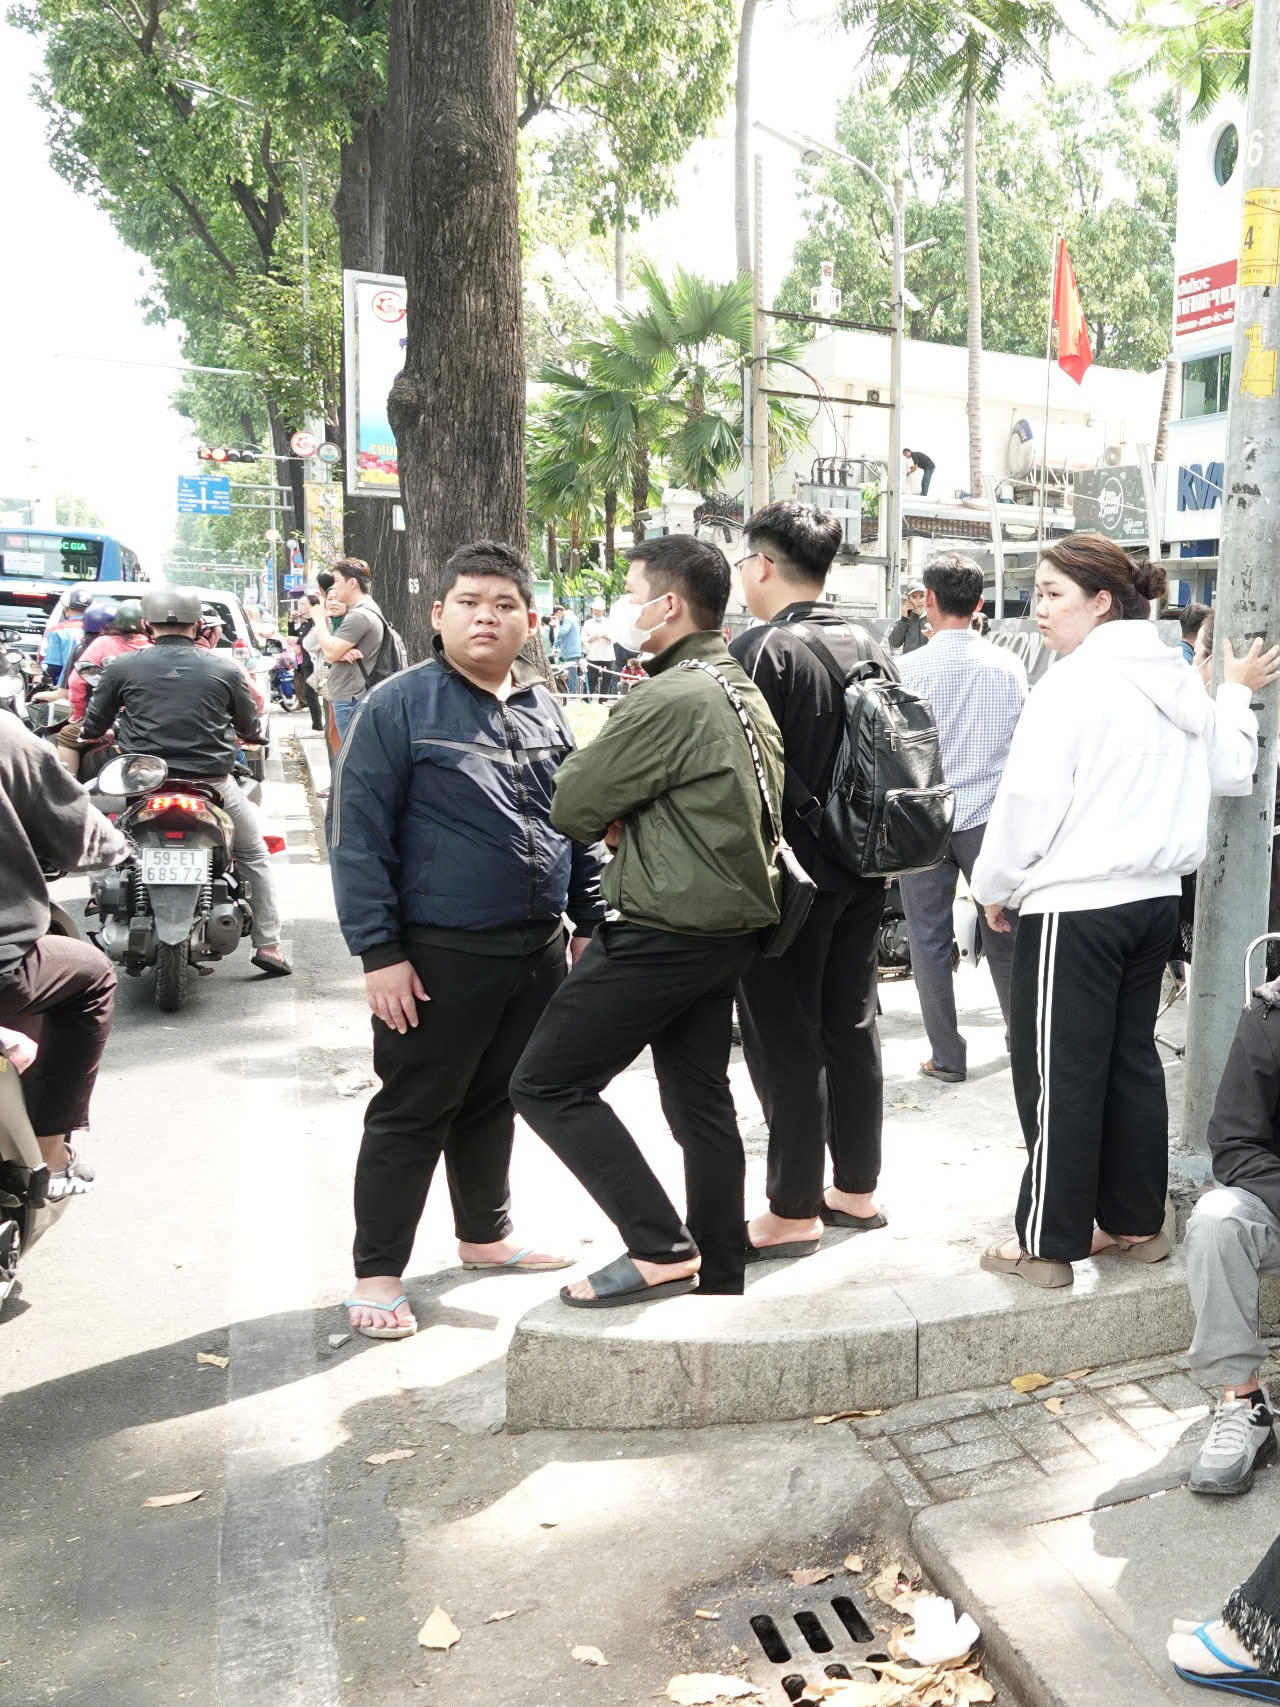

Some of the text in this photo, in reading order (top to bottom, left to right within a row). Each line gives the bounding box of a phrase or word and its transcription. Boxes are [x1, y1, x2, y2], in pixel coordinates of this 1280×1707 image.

[1244, 225, 1254, 250] 4
[71, 542, 87, 551] GIA
[408, 578, 420, 594] 65
[153, 852, 196, 866] 59-E1
